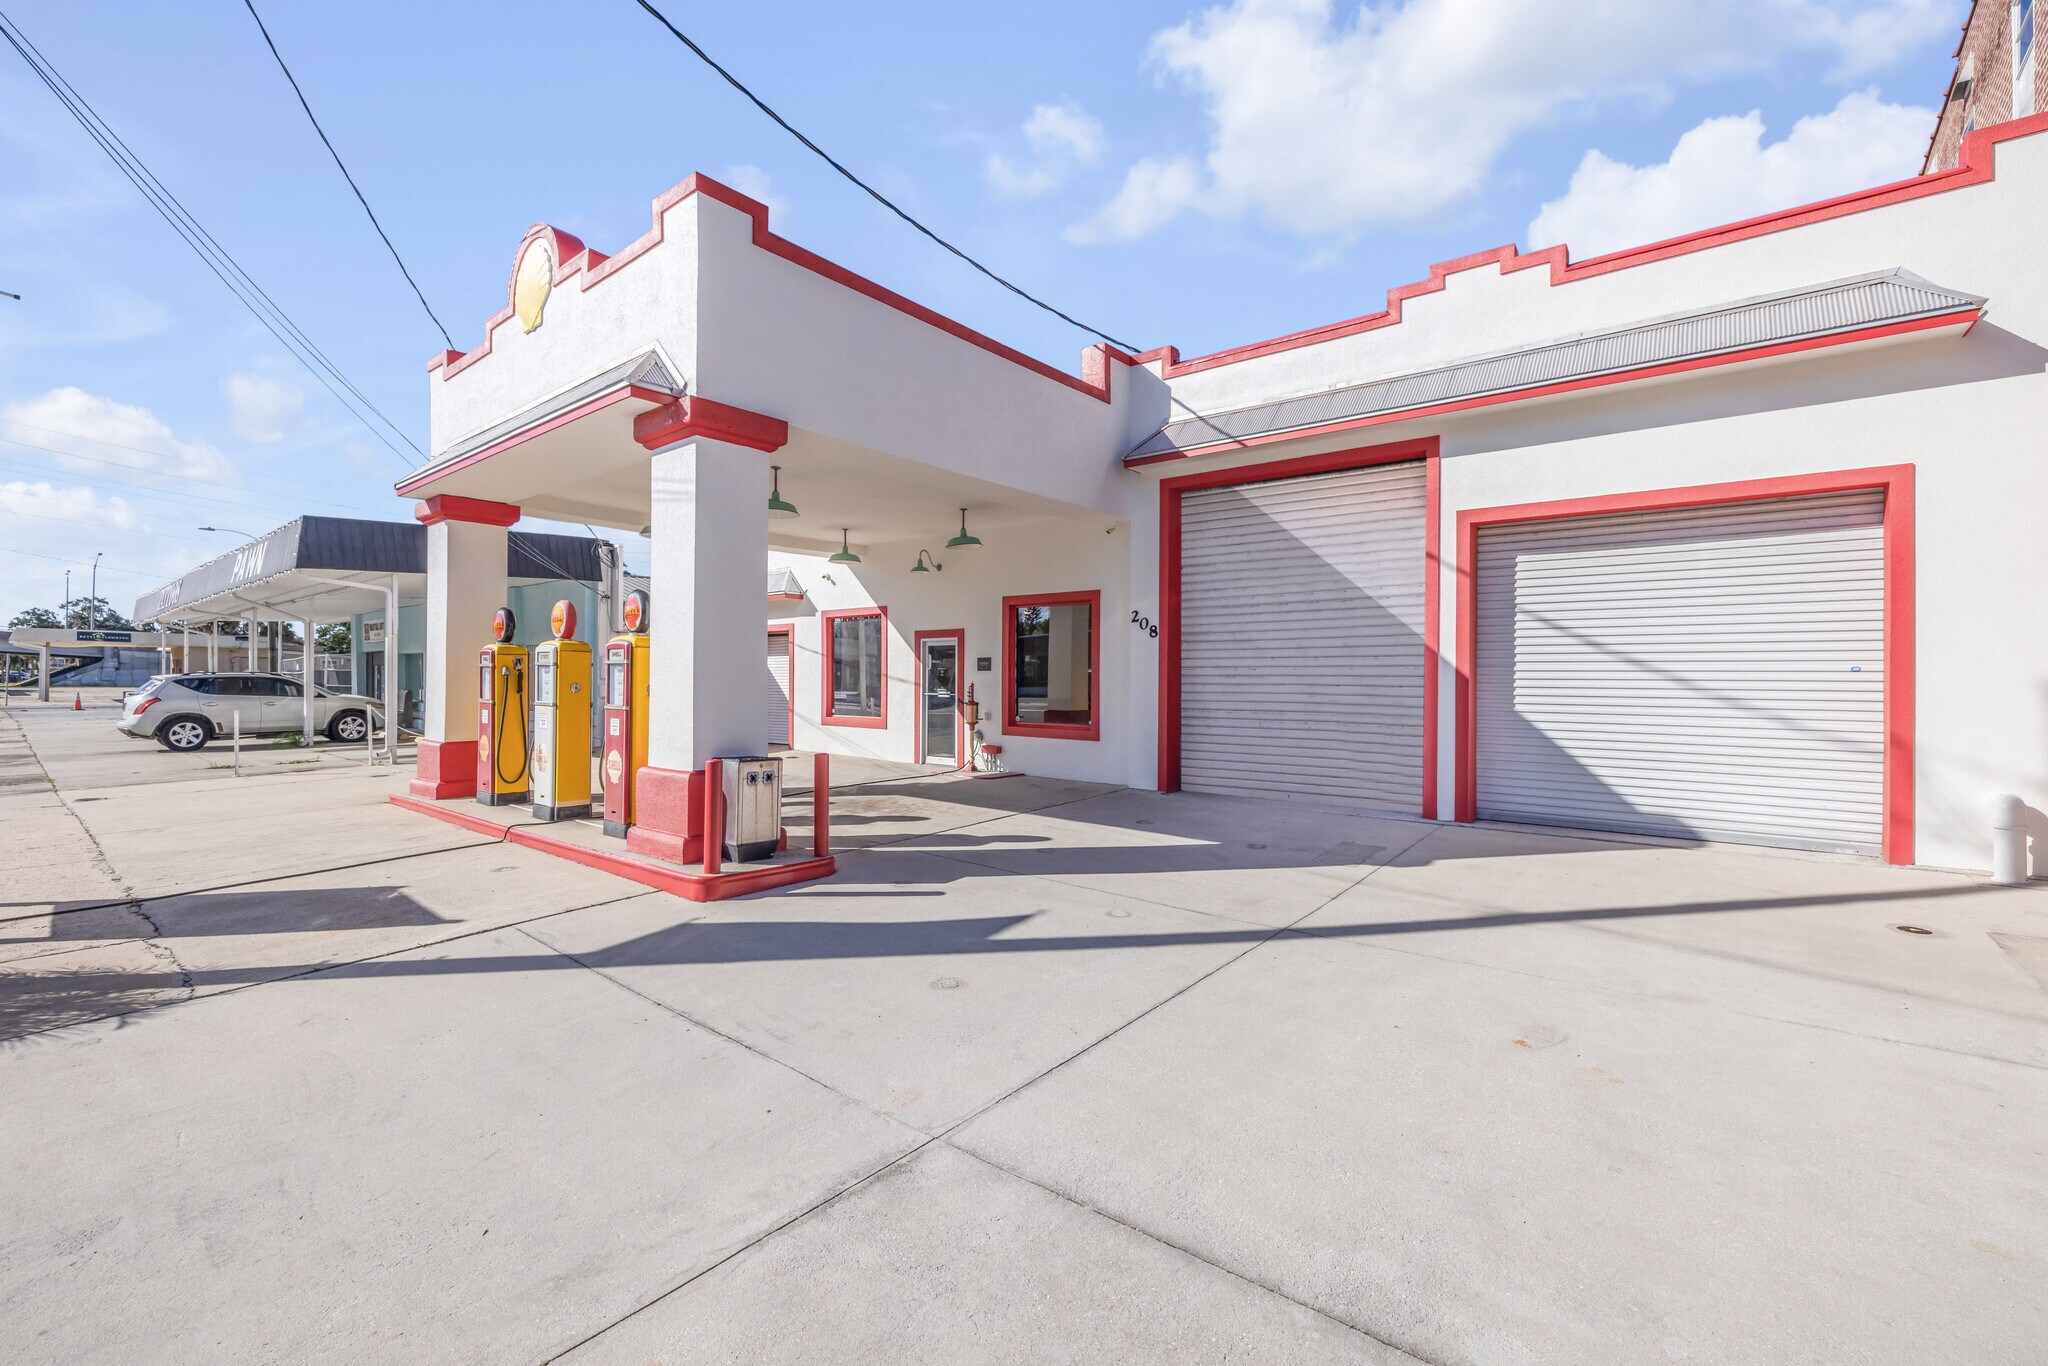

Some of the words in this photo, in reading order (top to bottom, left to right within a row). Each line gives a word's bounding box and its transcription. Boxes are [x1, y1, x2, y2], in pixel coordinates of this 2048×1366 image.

[230, 541, 268, 584] PAWN
[1131, 610, 1158, 638] 208
[608, 759, 621, 771] SHELL
